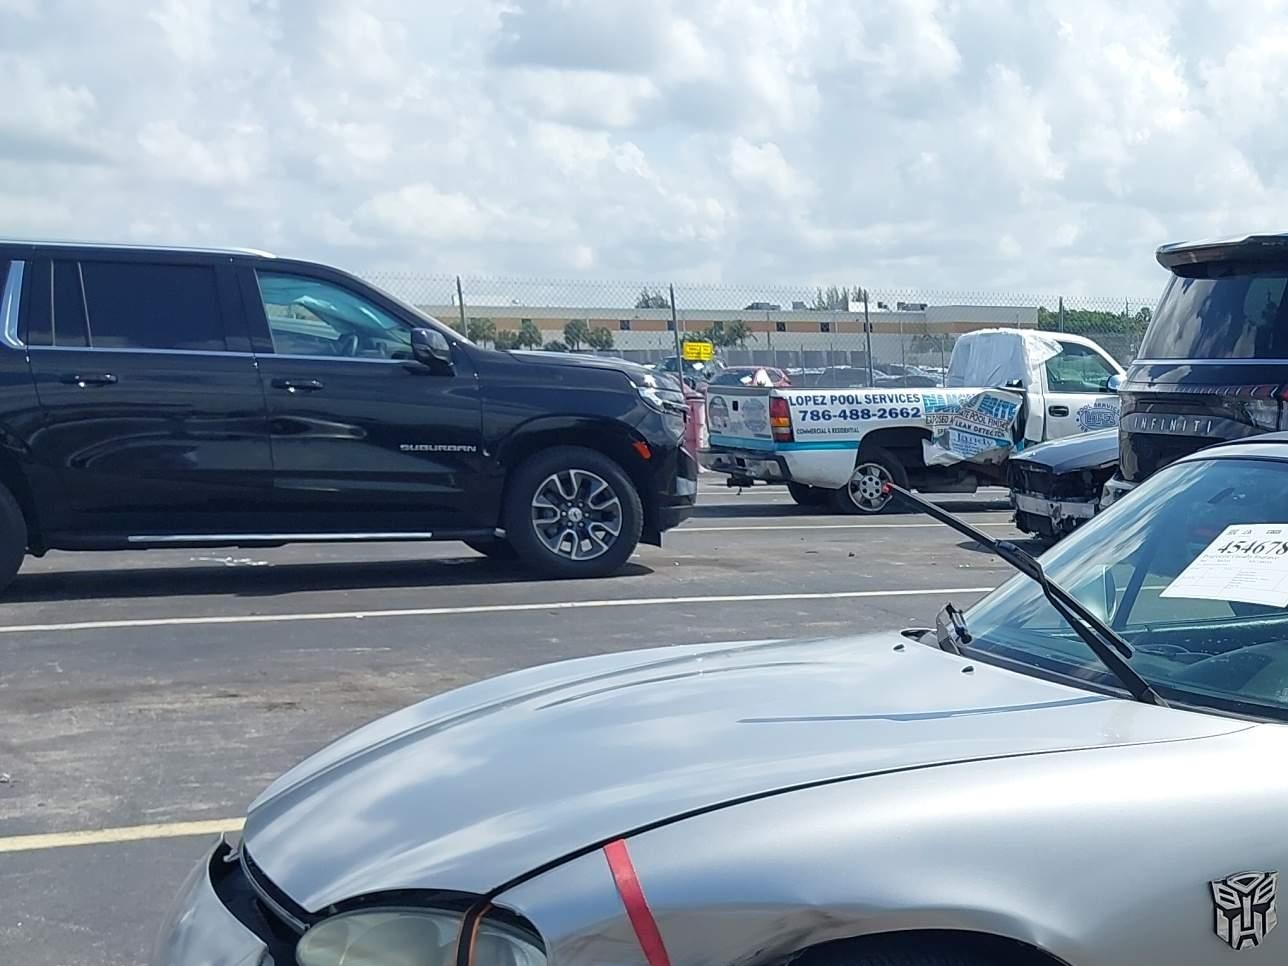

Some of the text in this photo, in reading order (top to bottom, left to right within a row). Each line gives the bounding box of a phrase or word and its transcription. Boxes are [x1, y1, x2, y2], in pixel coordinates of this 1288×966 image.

[789, 395, 828, 406] LOPEZ
[830, 394, 862, 405] POOL
[864, 393, 921, 405] SERVICES
[798, 407, 922, 421] 786-488-2662
[954, 420, 972, 431] LEAK
[1134, 416, 1211, 433] INFINITI
[399, 444, 477, 452] SUBURBAN
